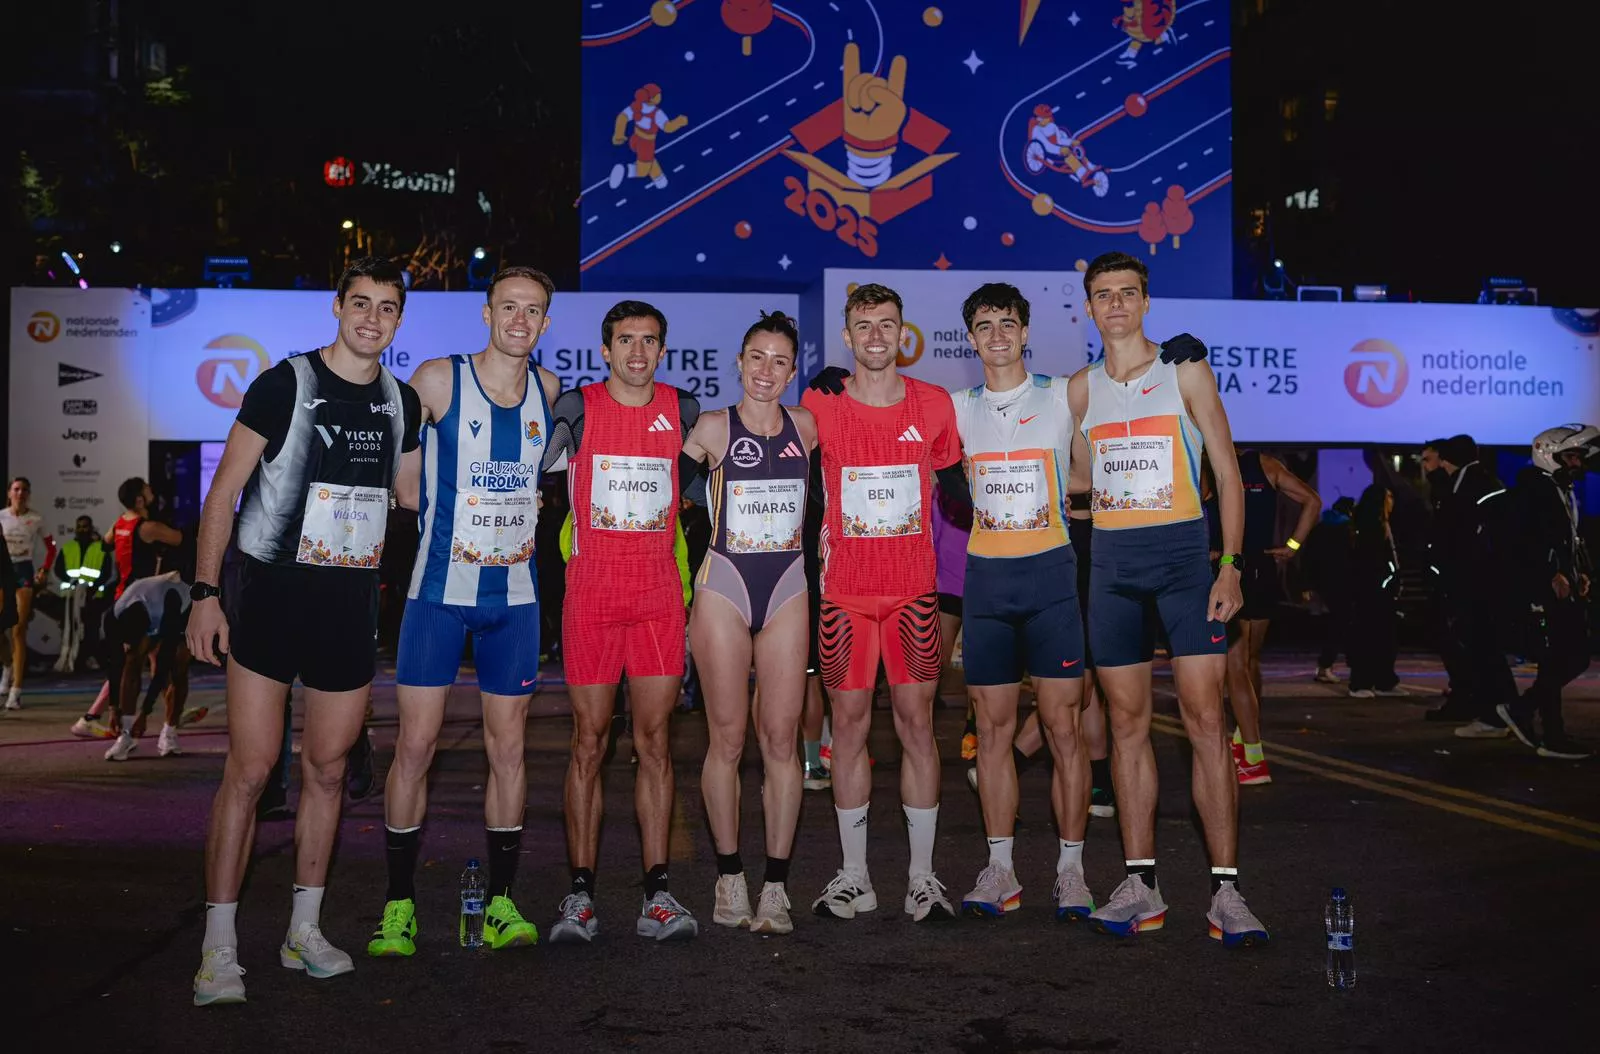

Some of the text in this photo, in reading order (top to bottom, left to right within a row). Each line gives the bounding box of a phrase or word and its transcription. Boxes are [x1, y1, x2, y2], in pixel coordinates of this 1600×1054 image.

[784, 176, 878, 257] 2025
[66, 316, 119, 326] nationale
[66, 327, 138, 338] nederlanden
[556, 348, 718, 371] SILTRE
[1210, 346, 1297, 369] ESTRE
[1422, 350, 1527, 370] nationale
[687, 376, 720, 398] 25
[1267, 374, 1298, 394] 25
[1421, 374, 1564, 396] nederlanden
[62, 428, 98, 443] Jeep
[345, 430, 384, 441] VICKY
[349, 442, 381, 451] FOODS
[732, 455, 762, 463] MAPOMA
[469, 461, 534, 476] GIPUZKOA
[1104, 459, 1159, 475] QUIJADA
[471, 475, 530, 489] KIROLAK
[608, 480, 658, 493] RAMOS
[985, 482, 1034, 495] ORIACH
[868, 488, 895, 500] BEN
[738, 501, 796, 515] VIÑARAS
[472, 514, 525, 527] DE BLAS
